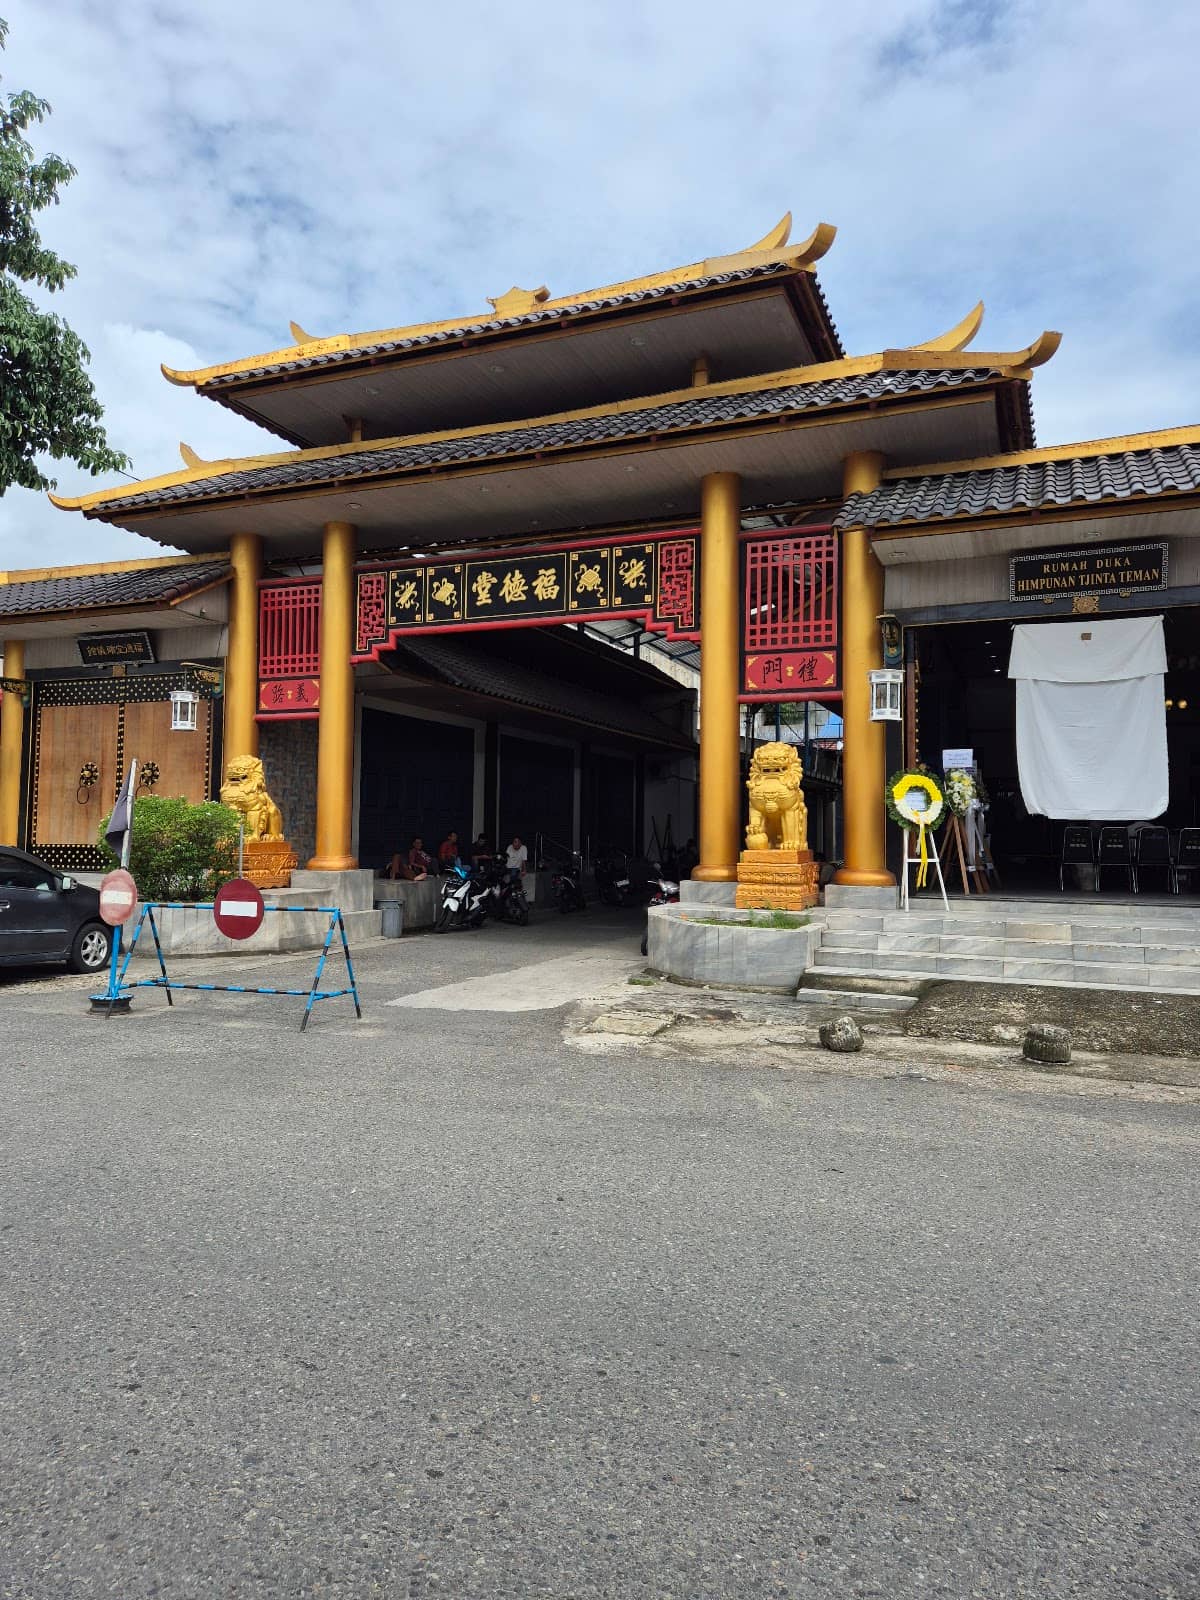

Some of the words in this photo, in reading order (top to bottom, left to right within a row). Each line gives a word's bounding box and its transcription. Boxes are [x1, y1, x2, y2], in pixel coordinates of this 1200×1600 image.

[1043, 560, 1088, 574] RUMAH
[1096, 556, 1132, 569] DUKA
[1017, 575, 1076, 592] HIMPUNAN
[1078, 571, 1117, 587] TJINTA
[1119, 568, 1161, 583] TEMAN
